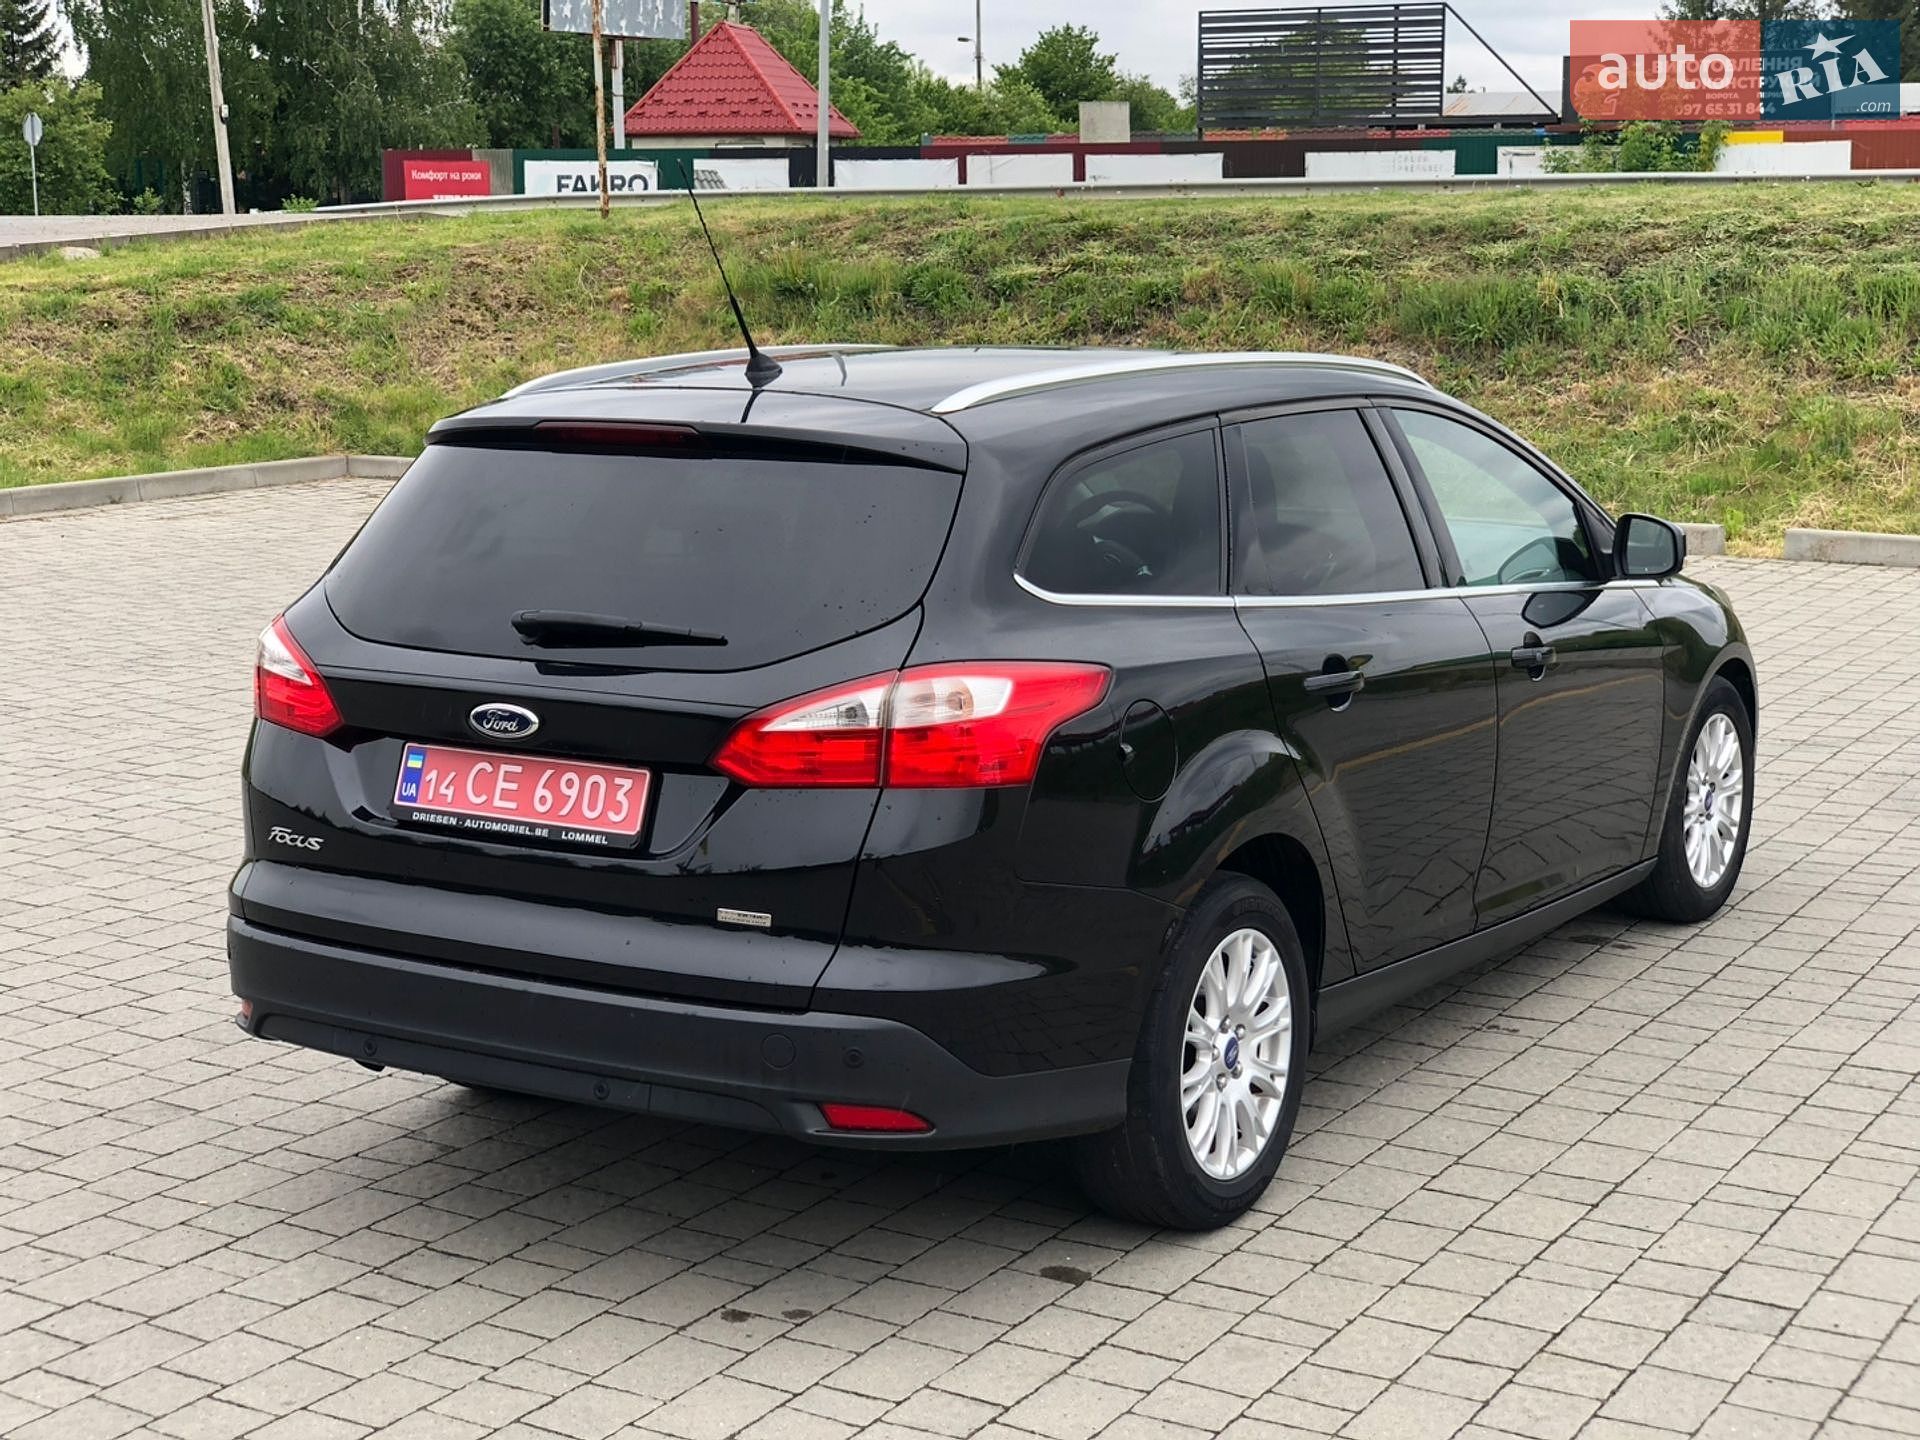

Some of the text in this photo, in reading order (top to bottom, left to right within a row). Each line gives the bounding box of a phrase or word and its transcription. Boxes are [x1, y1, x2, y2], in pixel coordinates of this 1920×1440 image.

[1705, 92, 1739, 100] ВОРОТА
[1705, 103, 1724, 115] 65
[1727, 103, 1741, 115] 31
[411, 169, 482, 182] Комфорт на роки
[482, 709, 519, 732] Ford
[401, 781, 416, 798] UA
[424, 761, 634, 824] 14 CE 6903
[412, 811, 457, 826] DRIESEN
[561, 830, 608, 845] LOMMEL
